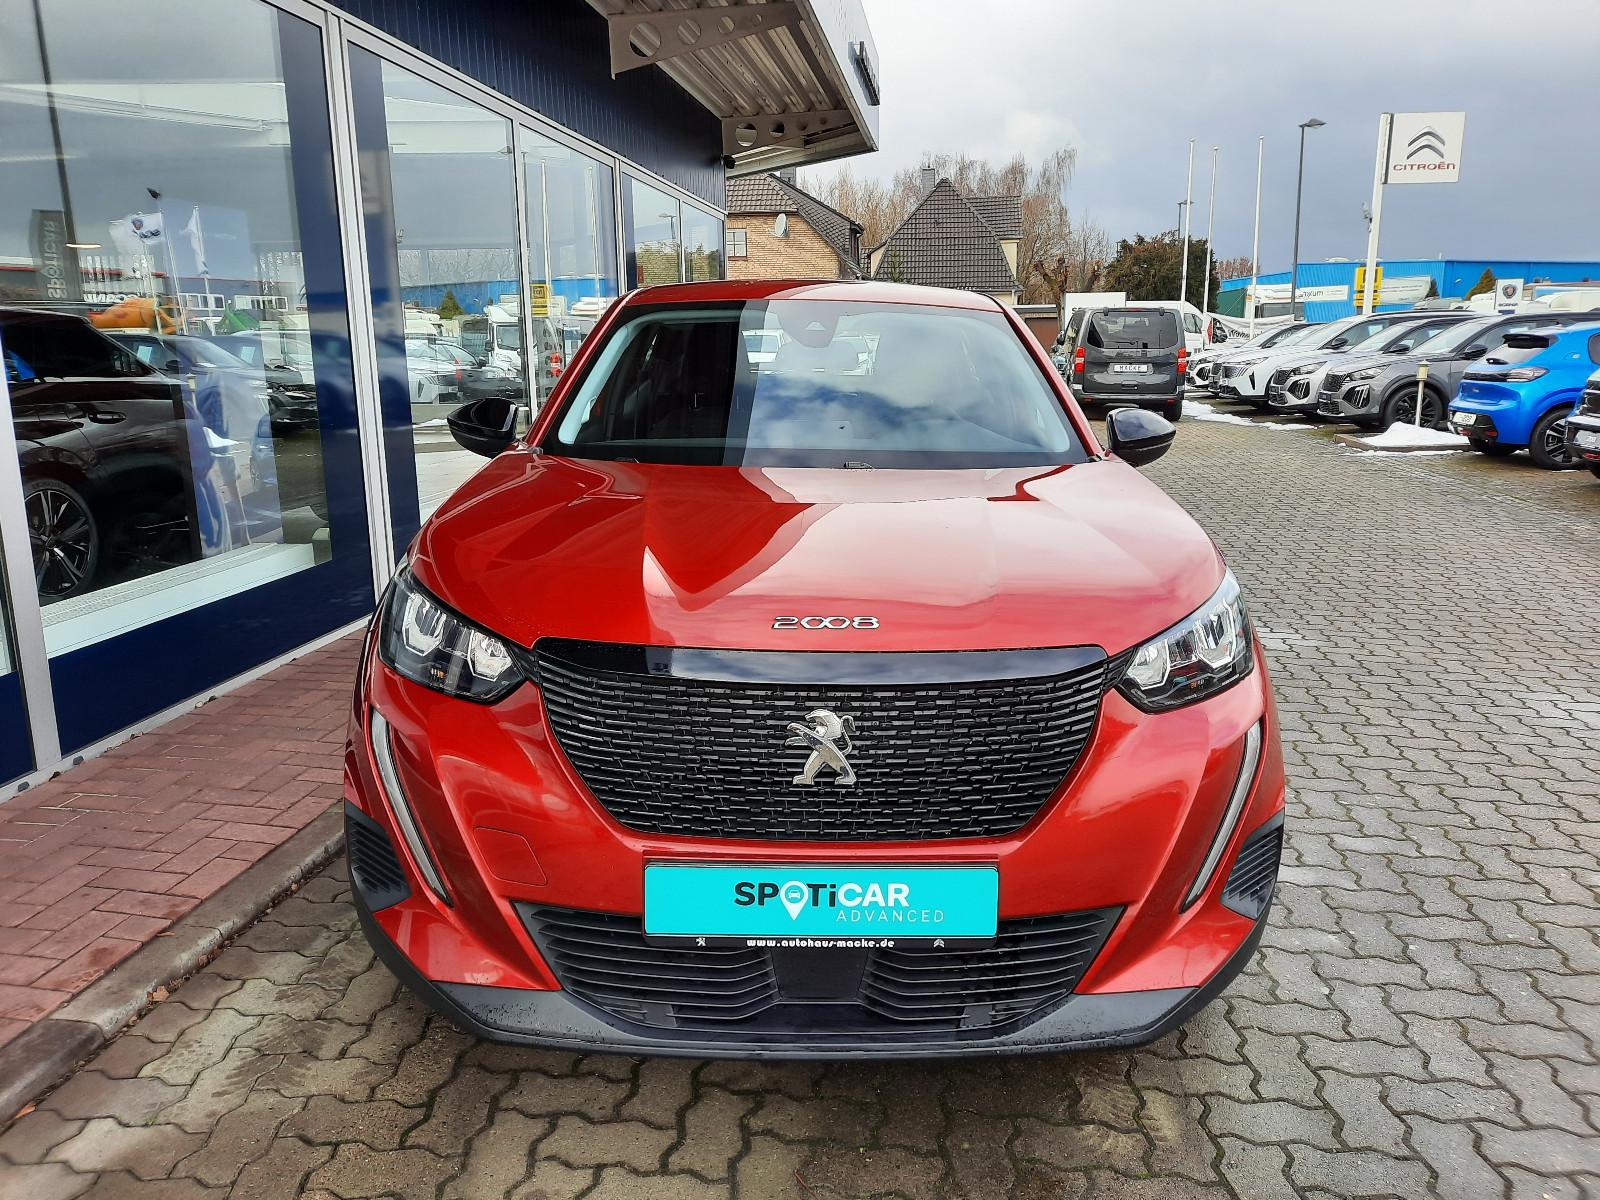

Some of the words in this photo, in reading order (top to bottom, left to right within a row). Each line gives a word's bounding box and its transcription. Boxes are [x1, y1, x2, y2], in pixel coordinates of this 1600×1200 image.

[771, 615, 880, 630] 2008
[836, 909, 945, 922] ADVANCED
[746, 938, 895, 948] www.autohaus-macke.de
